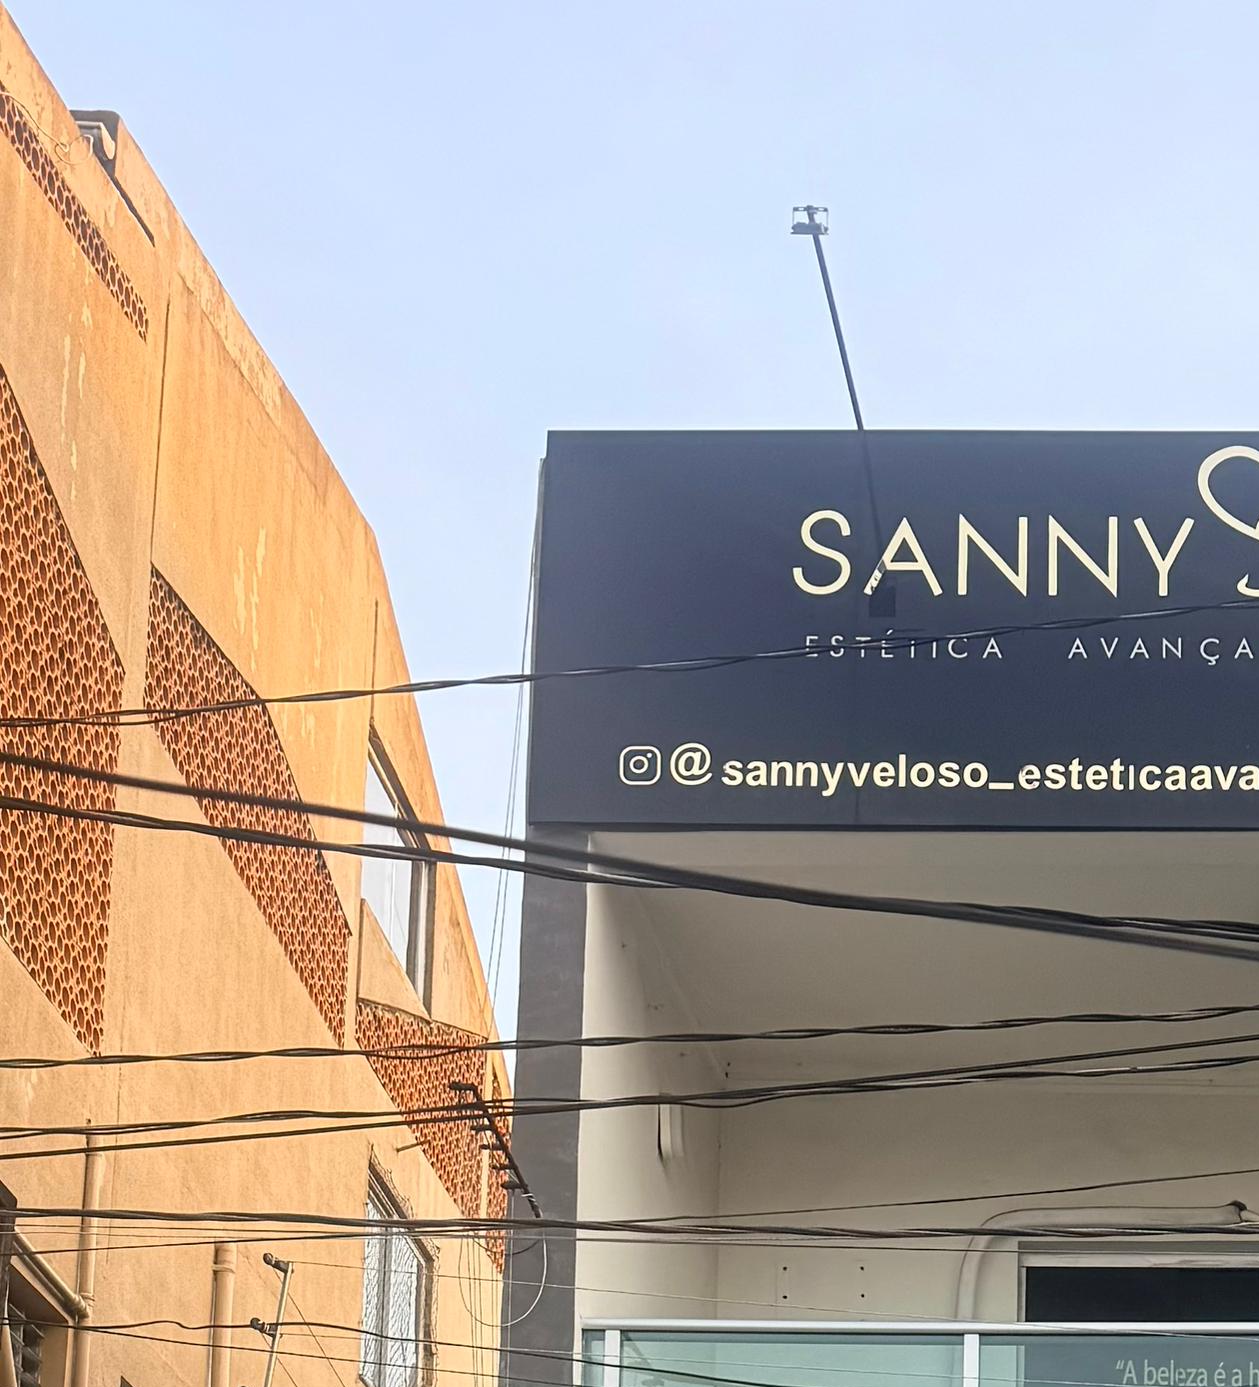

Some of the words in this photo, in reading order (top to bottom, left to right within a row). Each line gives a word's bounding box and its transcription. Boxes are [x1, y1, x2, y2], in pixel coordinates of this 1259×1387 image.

[793, 510, 1195, 598] SANNY
[1143, 1360, 1208, 1387] beleza
[1213, 1362, 1226, 1387] é
[1231, 1368, 1243, 1387] a
